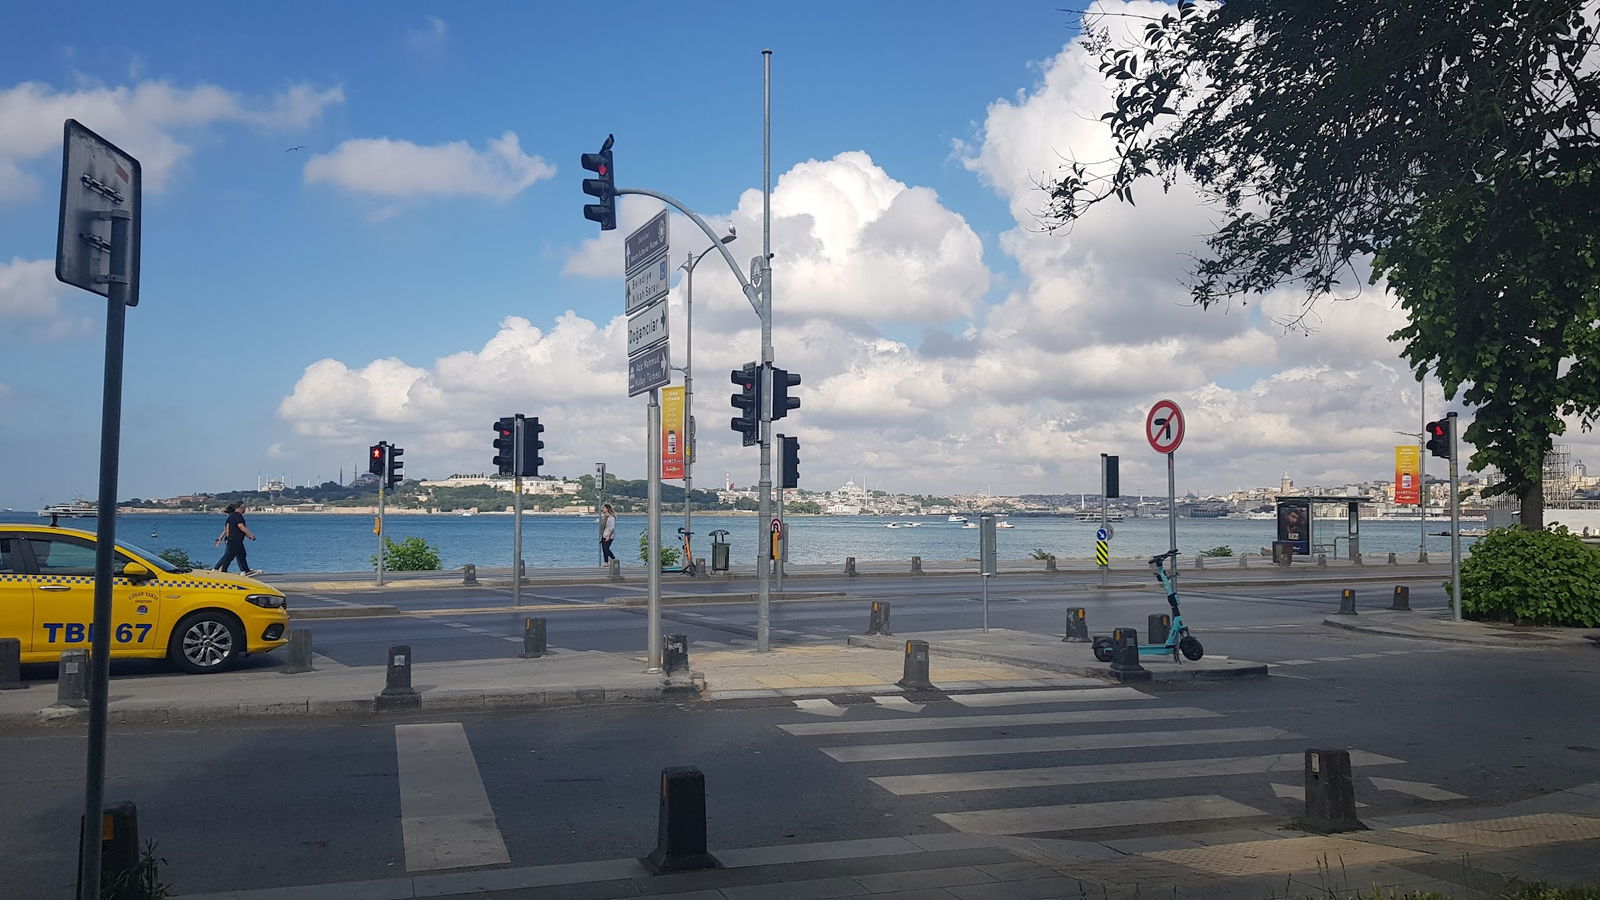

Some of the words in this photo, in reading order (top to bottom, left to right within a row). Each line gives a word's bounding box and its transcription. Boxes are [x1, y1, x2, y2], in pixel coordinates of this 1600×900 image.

[632, 271, 652, 290] Belediye
[629, 317, 659, 345] Doğancılar
[115, 623, 152, 643] 67
